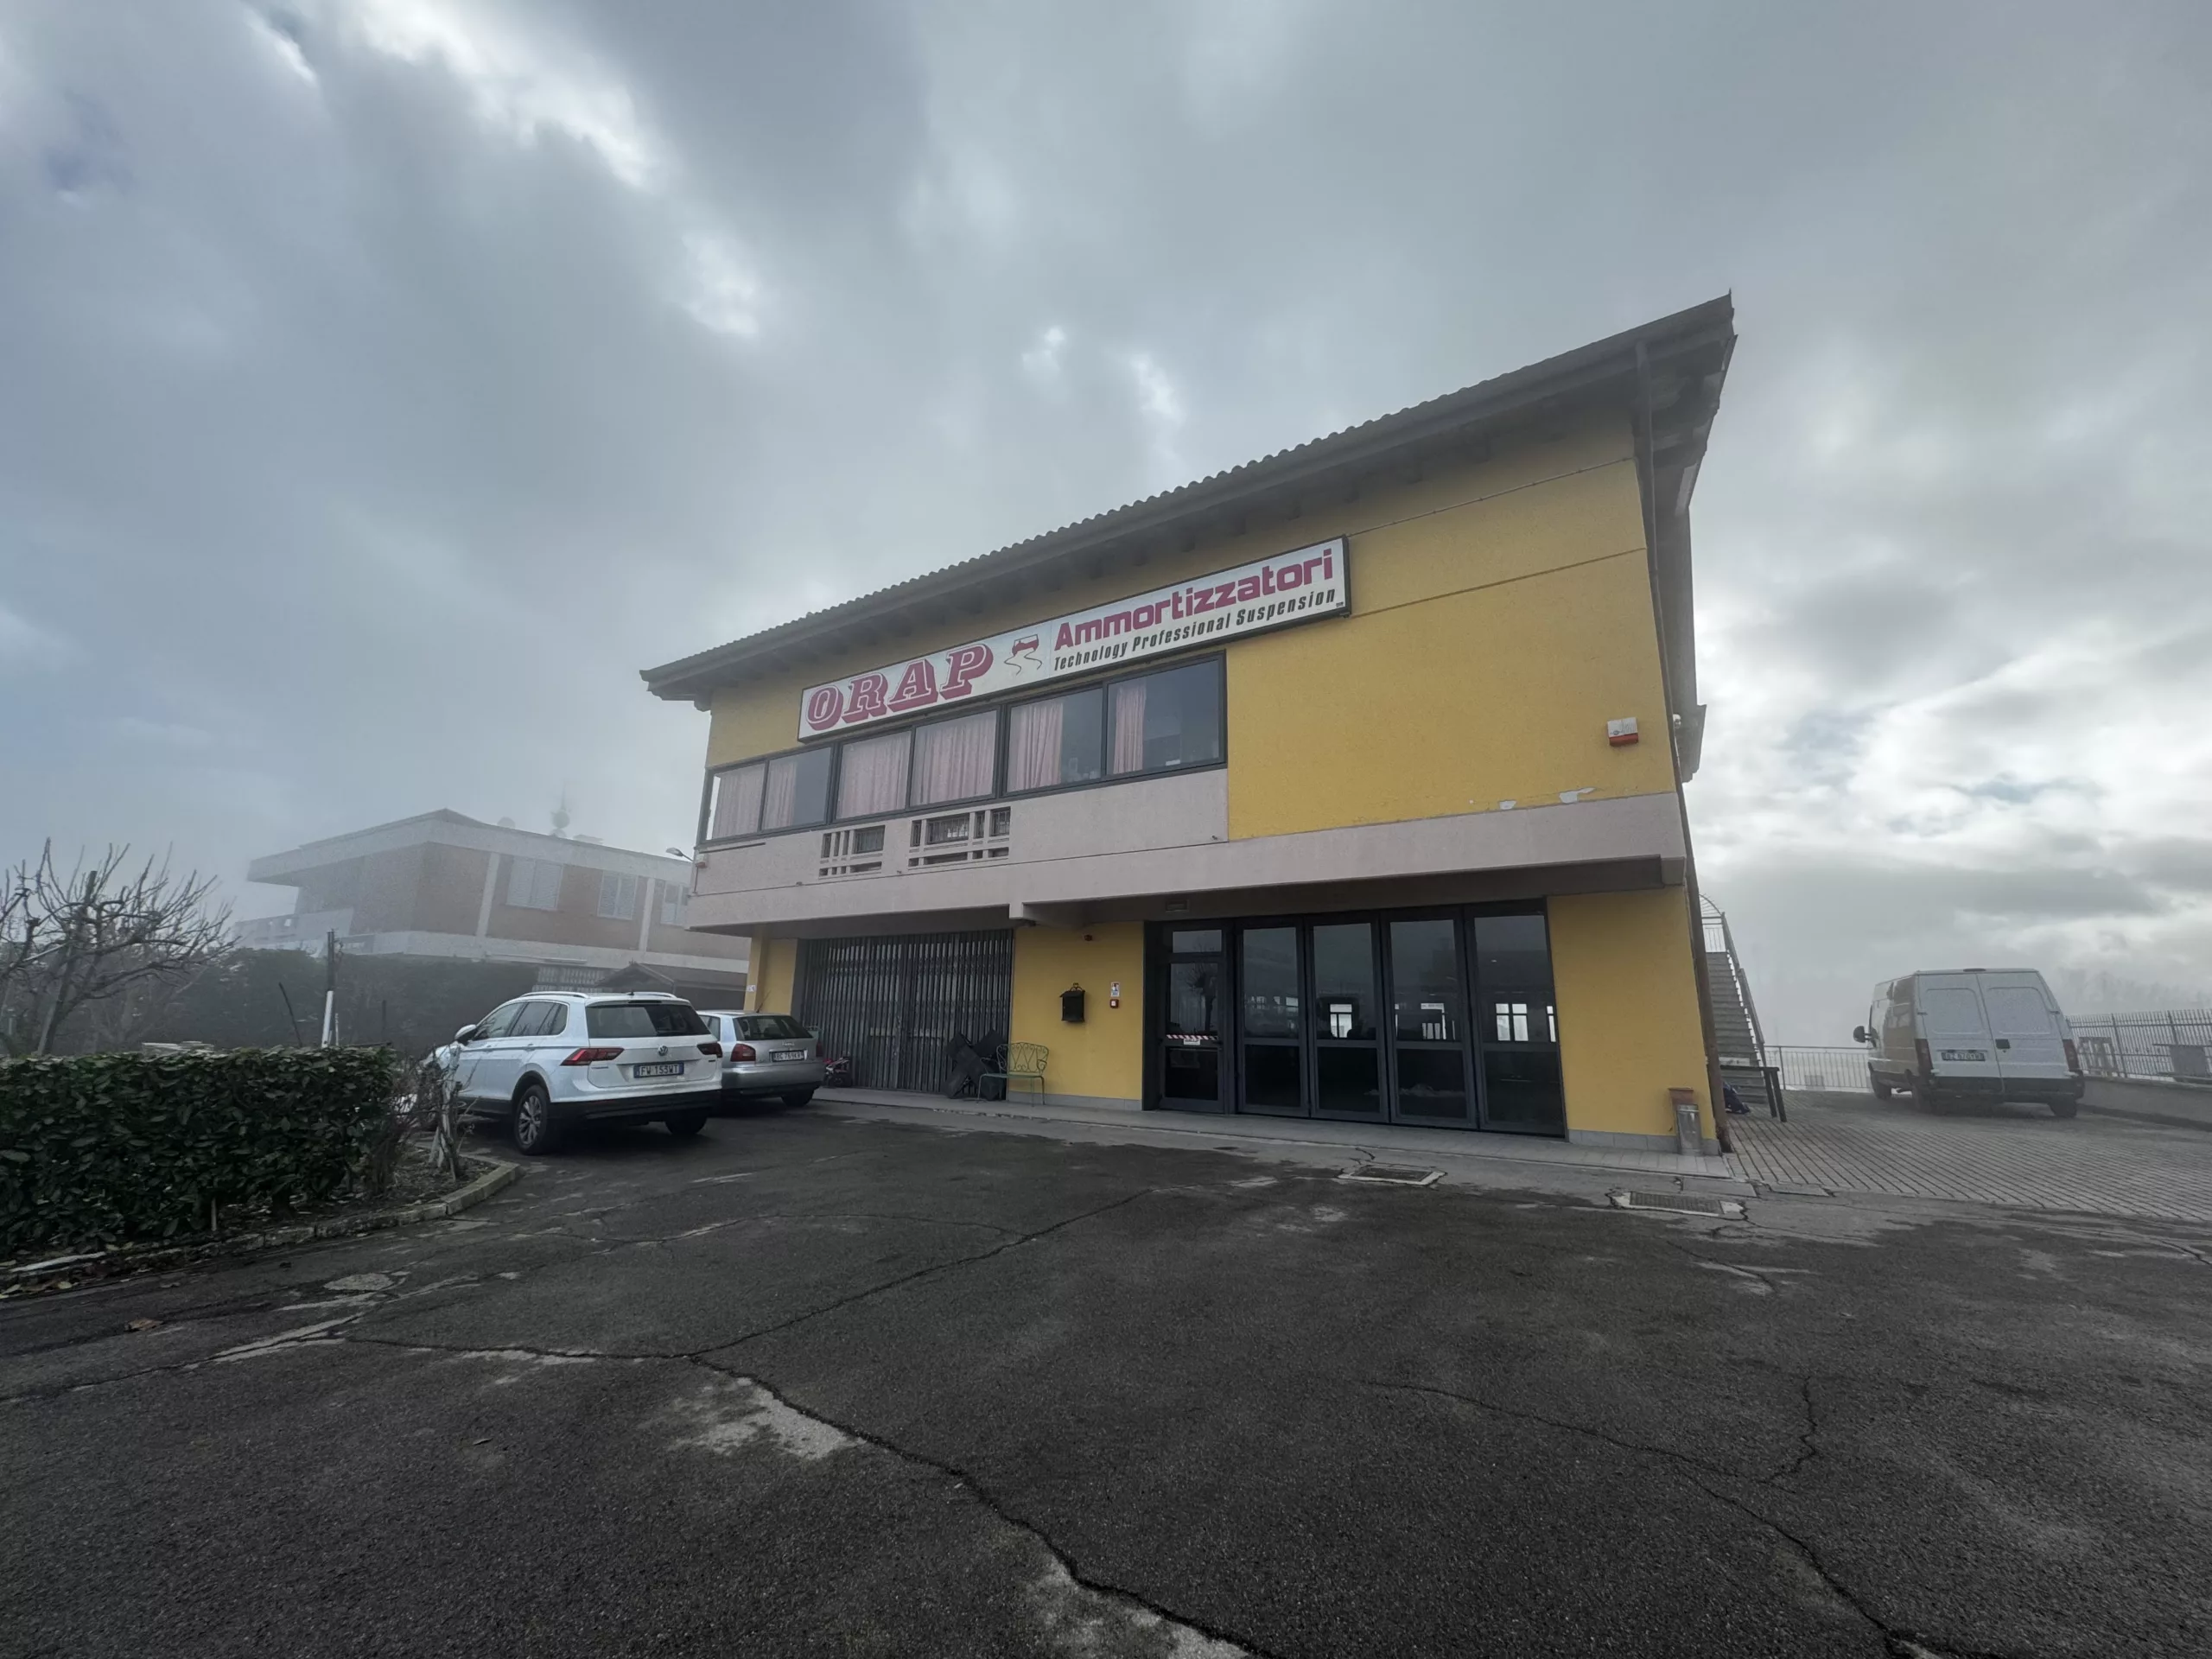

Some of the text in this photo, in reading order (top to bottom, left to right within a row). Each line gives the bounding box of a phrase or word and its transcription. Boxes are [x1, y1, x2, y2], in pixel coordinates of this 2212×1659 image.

[1054, 548, 1332, 651] Ammortizzatori
[1054, 588, 1335, 671] Technology Professional Suspension
[805, 644, 994, 731] ORAP
